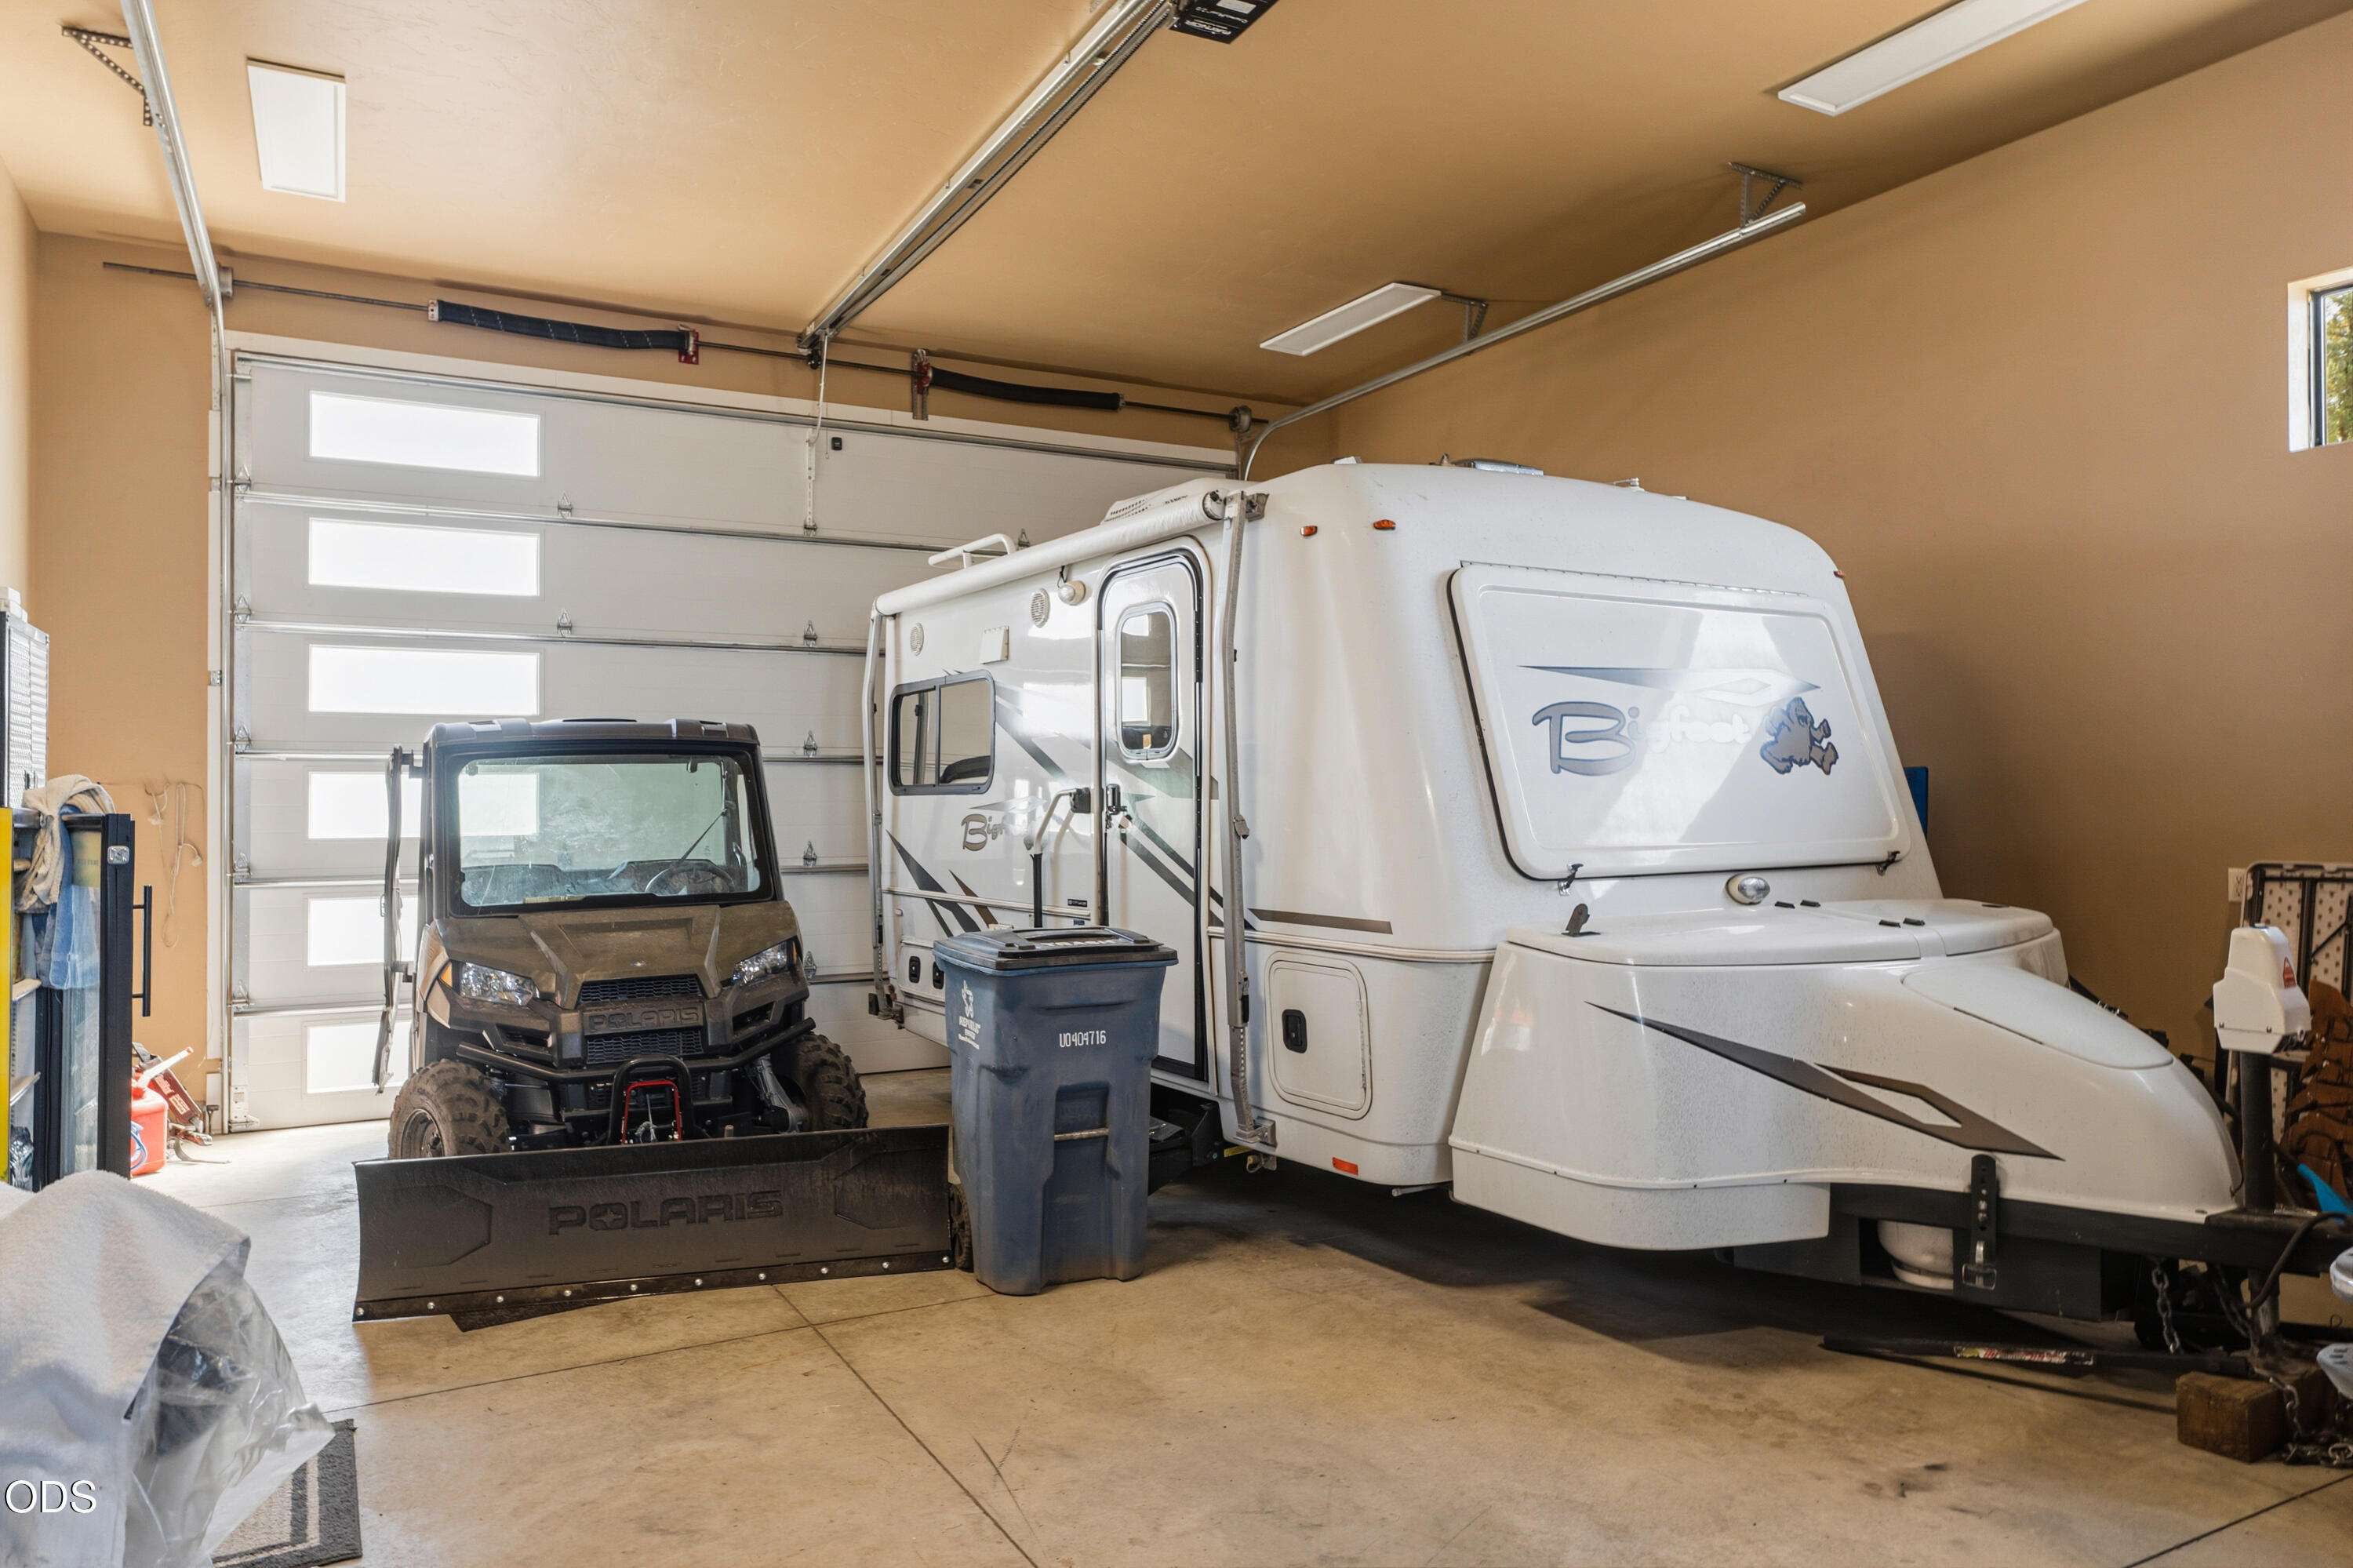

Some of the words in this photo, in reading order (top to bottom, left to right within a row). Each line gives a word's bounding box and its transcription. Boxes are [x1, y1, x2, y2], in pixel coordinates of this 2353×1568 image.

[1532, 700, 1752, 777] Bigfoot
[591, 1006, 700, 1032] POLARIS
[548, 1190, 783, 1236] POLARIS
